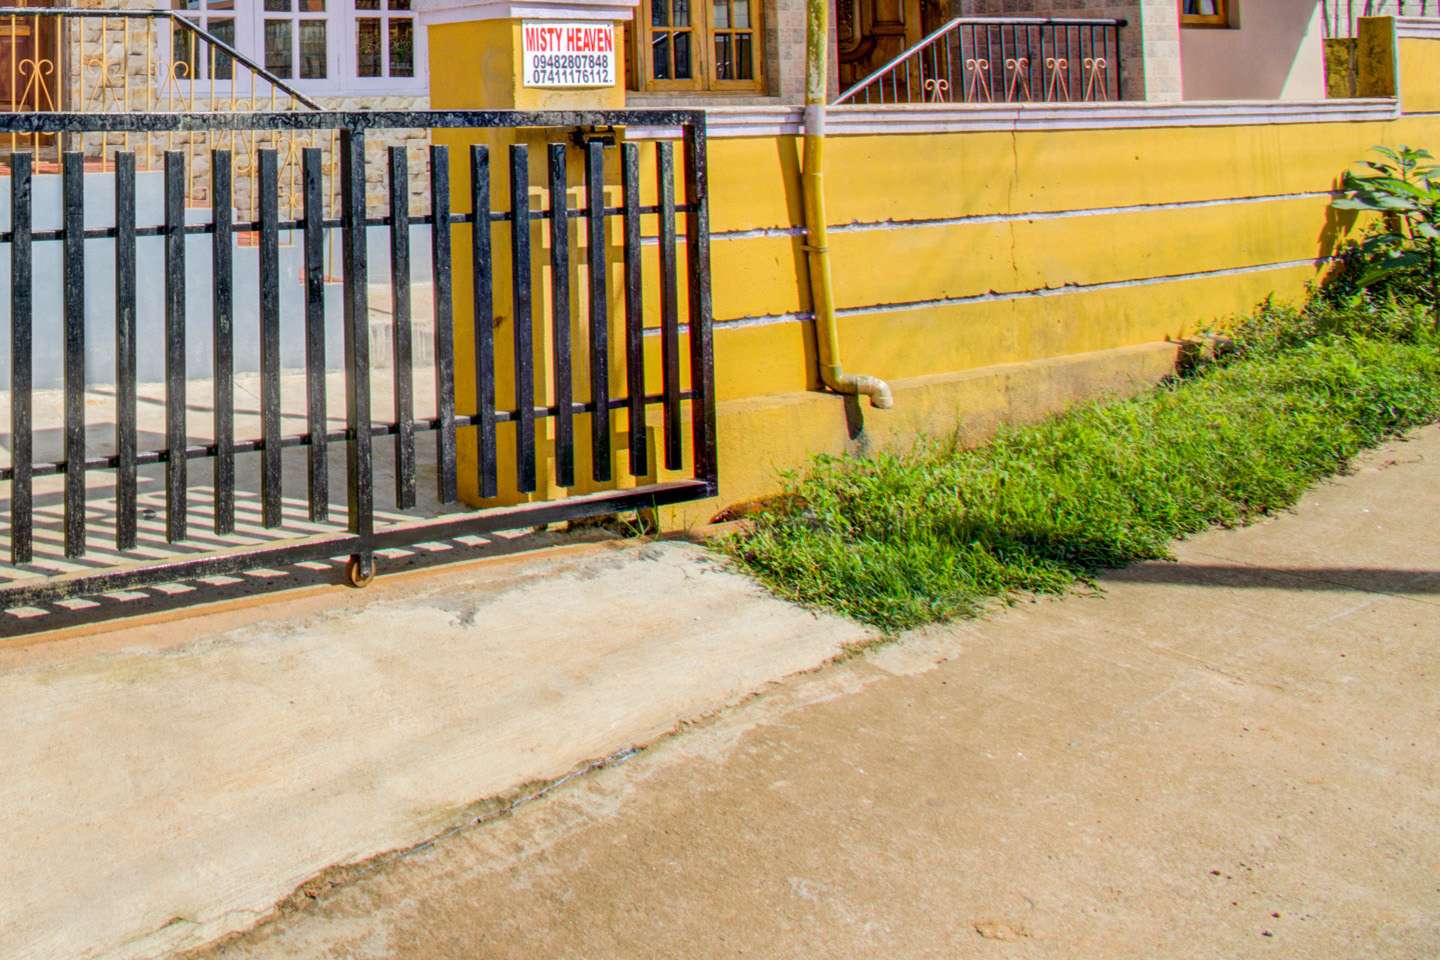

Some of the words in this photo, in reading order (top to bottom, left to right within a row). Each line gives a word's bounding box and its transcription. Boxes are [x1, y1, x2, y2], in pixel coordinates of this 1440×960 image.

[525, 27, 563, 52] MISTY
[566, 28, 612, 52] HEAVEN
[533, 55, 609, 69] 09482807848
[533, 69, 609, 84] 07411176112
